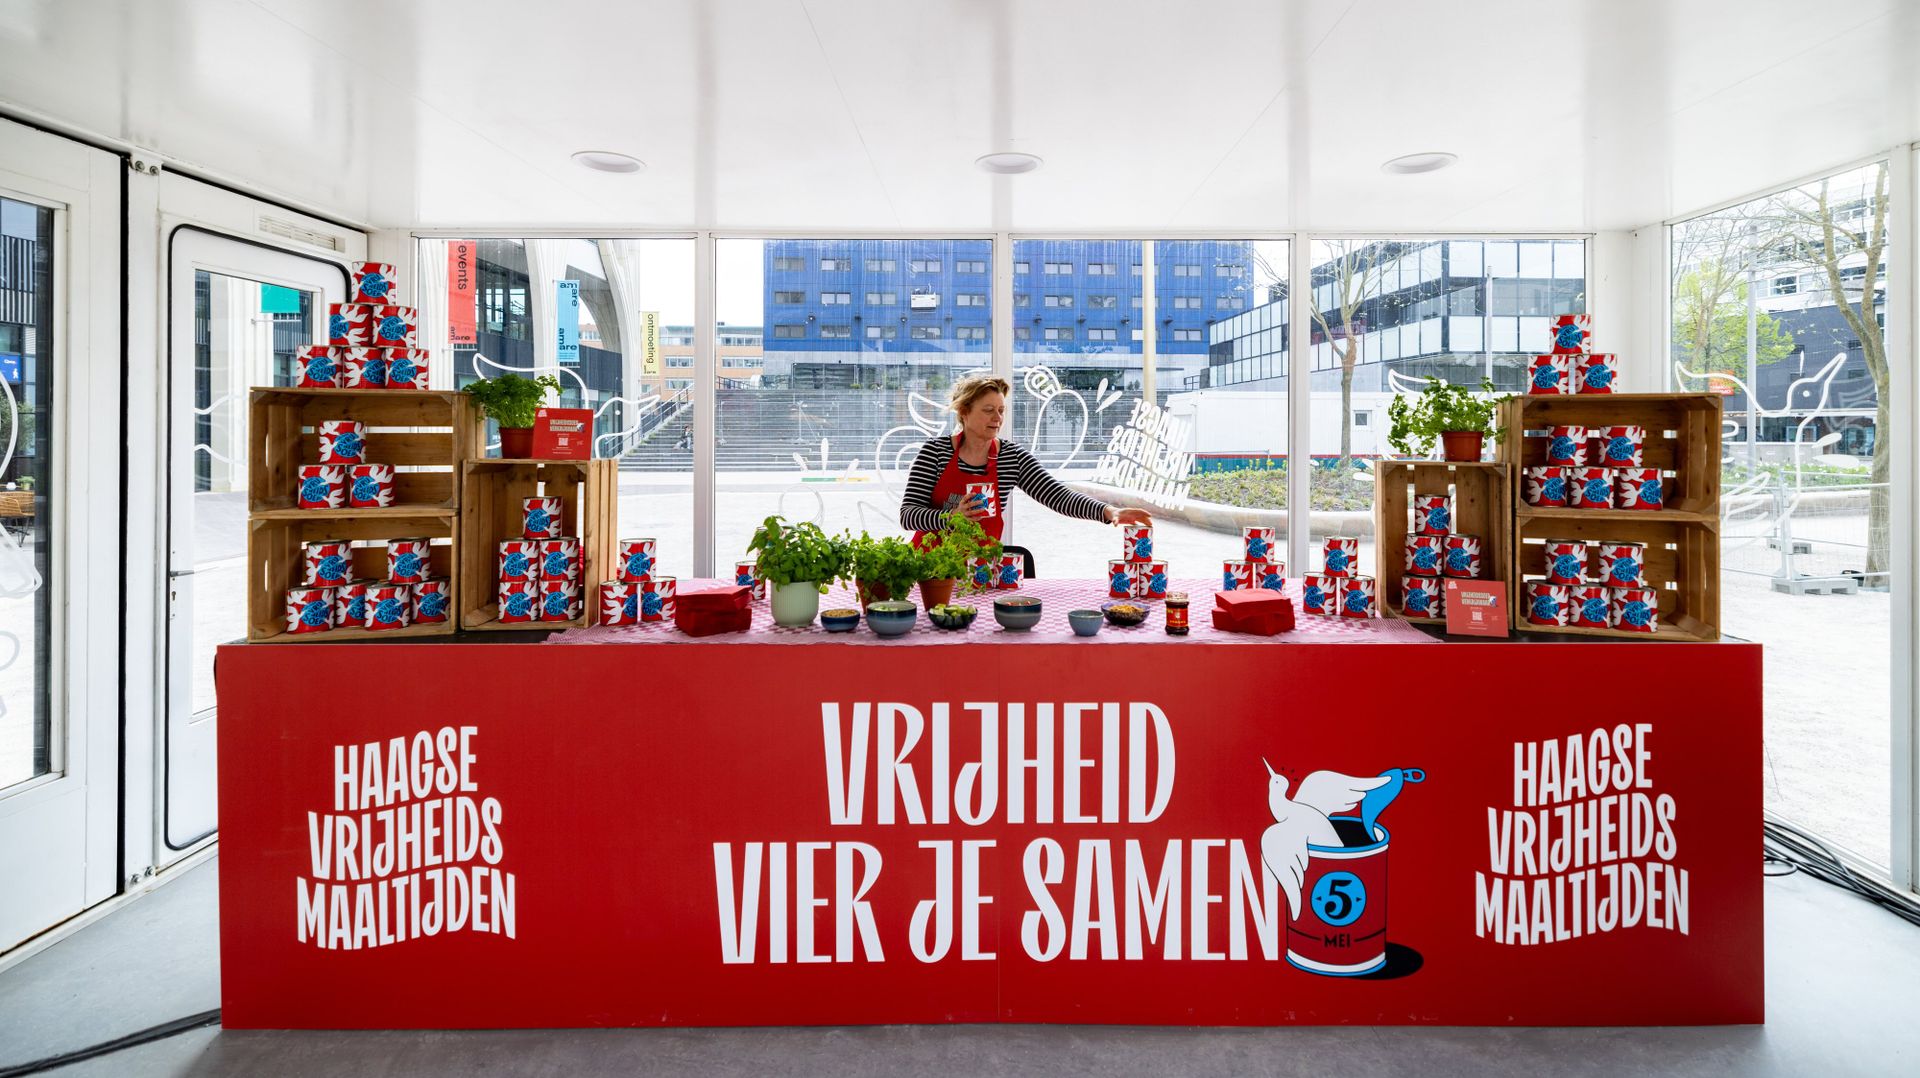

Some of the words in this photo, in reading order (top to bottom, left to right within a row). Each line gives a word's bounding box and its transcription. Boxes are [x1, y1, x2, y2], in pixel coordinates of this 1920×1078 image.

[458, 245, 469, 290] events
[646, 313, 654, 364] ontmoeting
[334, 726, 478, 811] HAAGSE
[821, 702, 1176, 826] VRIJHEID
[1514, 723, 1652, 807] HAAGSE
[308, 796, 503, 881] VRIJHEIDS
[1487, 792, 1677, 876] VRIJHEIDS
[297, 866, 516, 950] MAALTIJDEN
[713, 842, 885, 964] VIER
[909, 840, 997, 962] JE
[1021, 837, 1279, 962] SAMEN
[1324, 879, 1352, 919] 5
[1324, 934, 1352, 948] MEI
[1475, 862, 1689, 945] MAALTIJDEN
